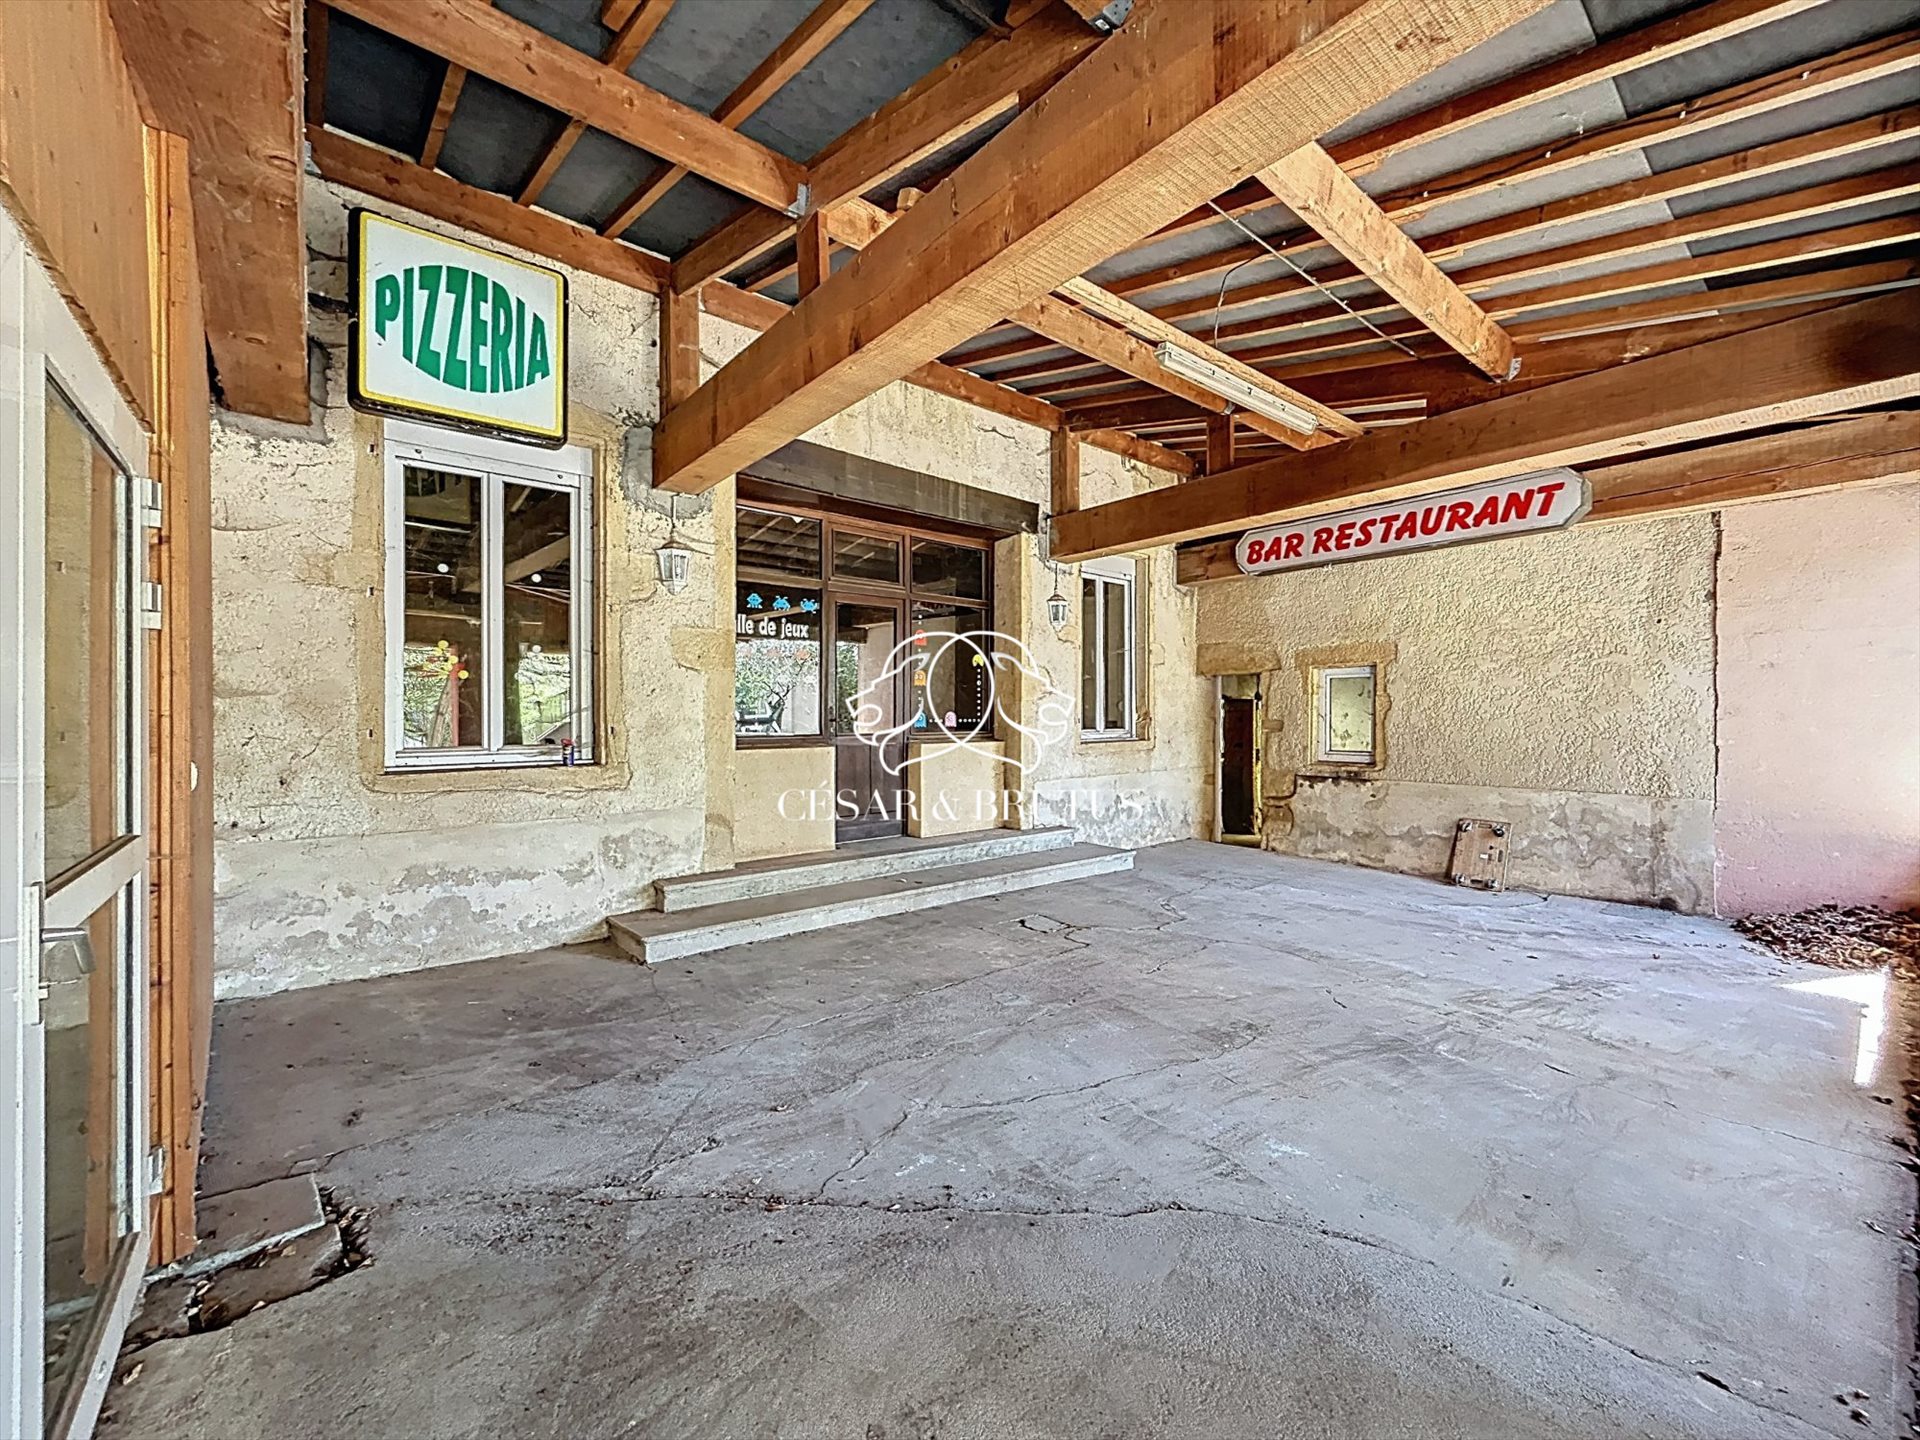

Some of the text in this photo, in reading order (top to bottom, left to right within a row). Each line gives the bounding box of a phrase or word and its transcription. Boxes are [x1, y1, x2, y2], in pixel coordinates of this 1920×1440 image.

[375, 265, 550, 393] PIZZERIA
[1246, 482, 1565, 565] BAR RESTAURANT
[758, 616, 777, 636] de
[780, 617, 810, 639] jeux
